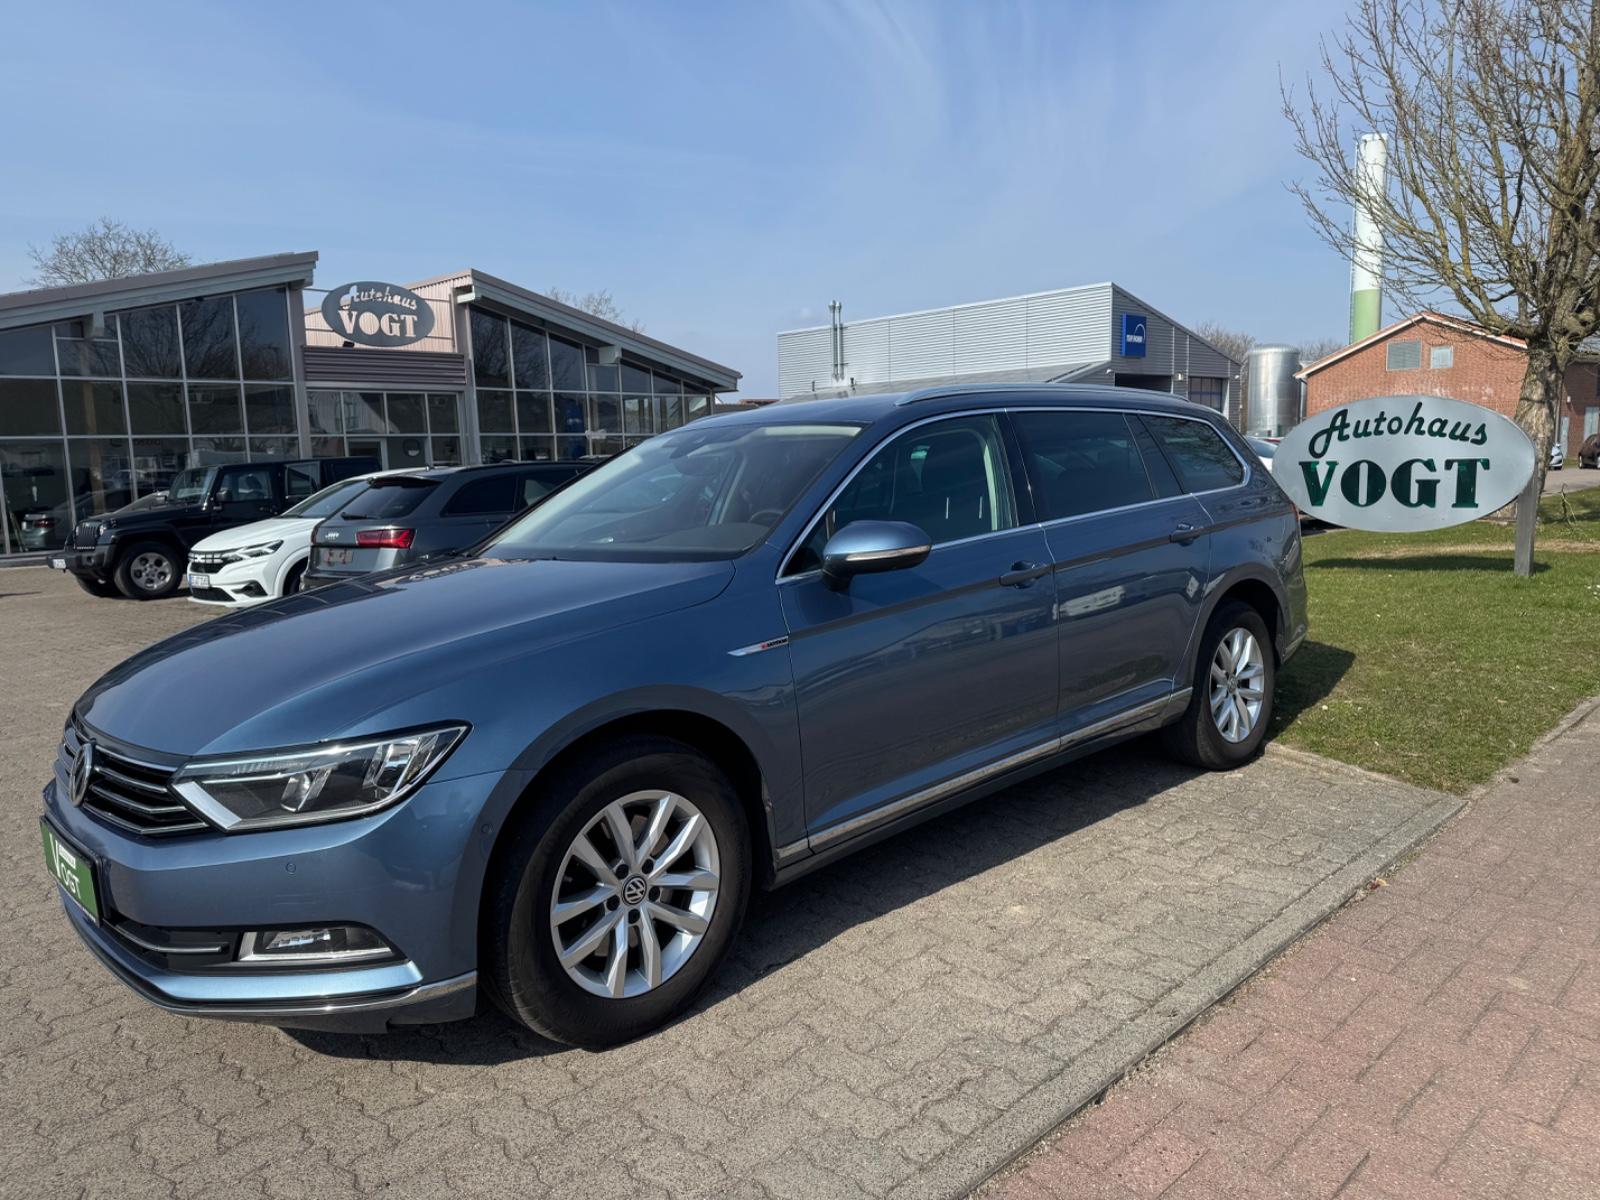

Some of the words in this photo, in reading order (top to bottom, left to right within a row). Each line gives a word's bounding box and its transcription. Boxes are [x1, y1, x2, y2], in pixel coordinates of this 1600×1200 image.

[339, 286, 417, 310] Autohaus
[338, 310, 418, 337] VOGT
[1308, 401, 1488, 458] Autohaus
[1298, 458, 1490, 508] VOGT
